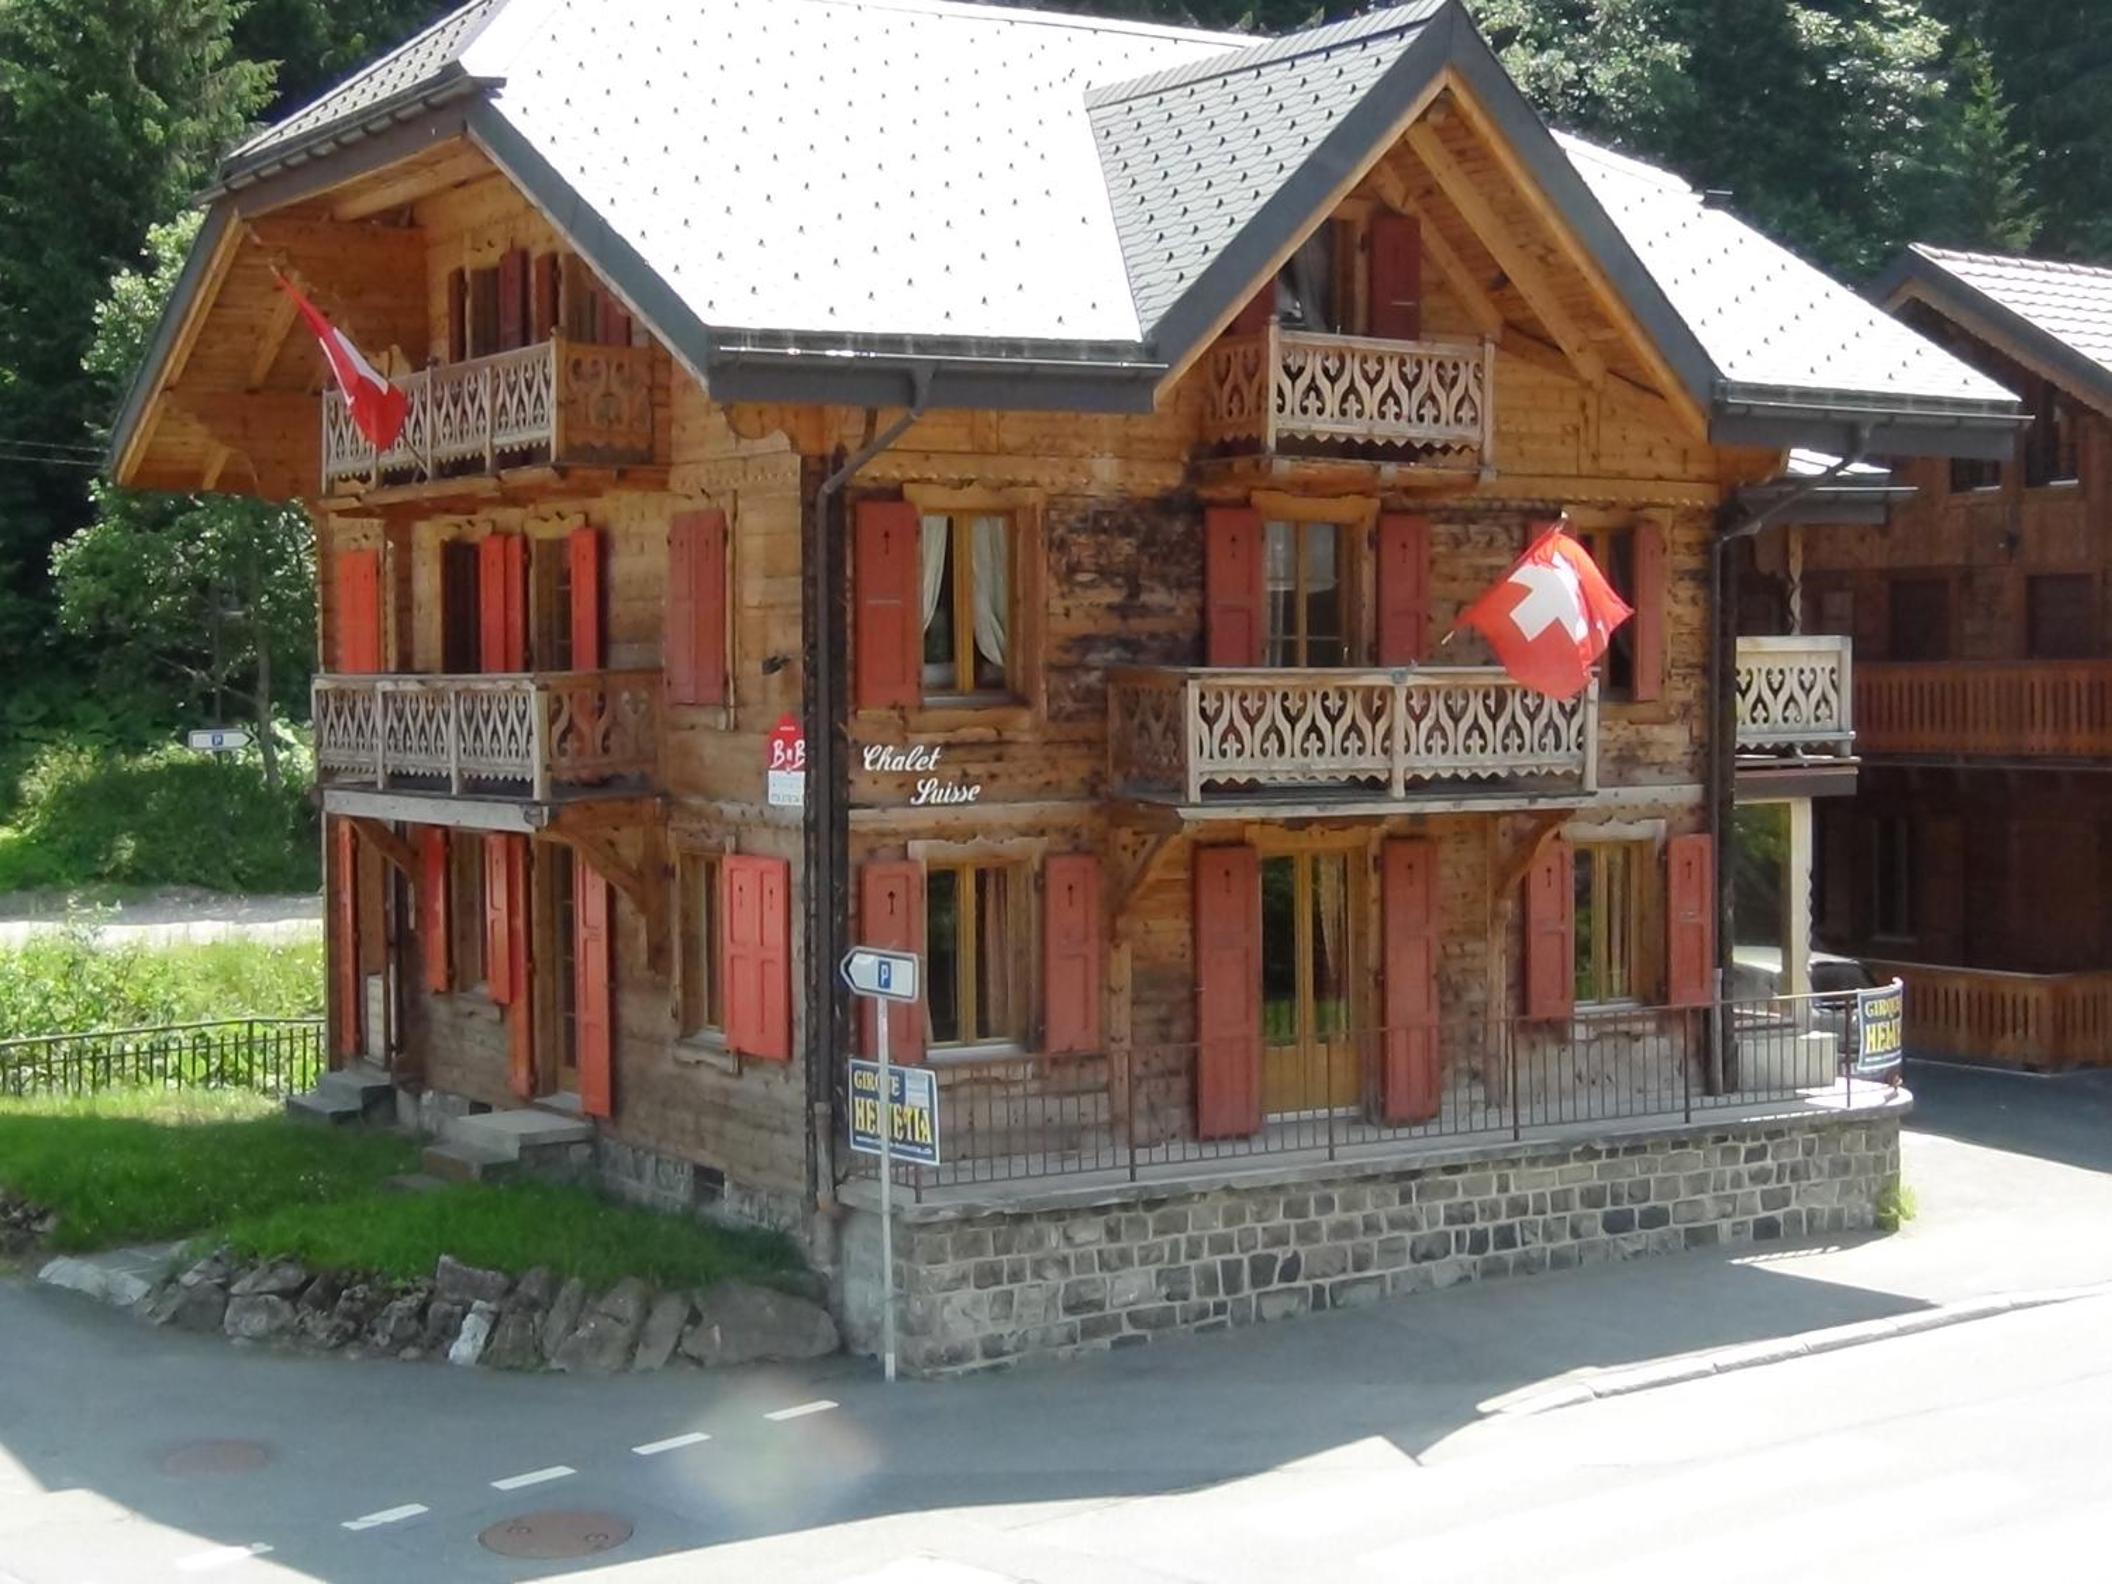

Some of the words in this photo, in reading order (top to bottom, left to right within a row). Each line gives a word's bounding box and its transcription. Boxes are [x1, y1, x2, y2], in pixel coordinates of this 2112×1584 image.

[863, 744, 941, 772] Chalet
[909, 777, 981, 805] Suisse
[854, 1096, 933, 1144] HEETIA
